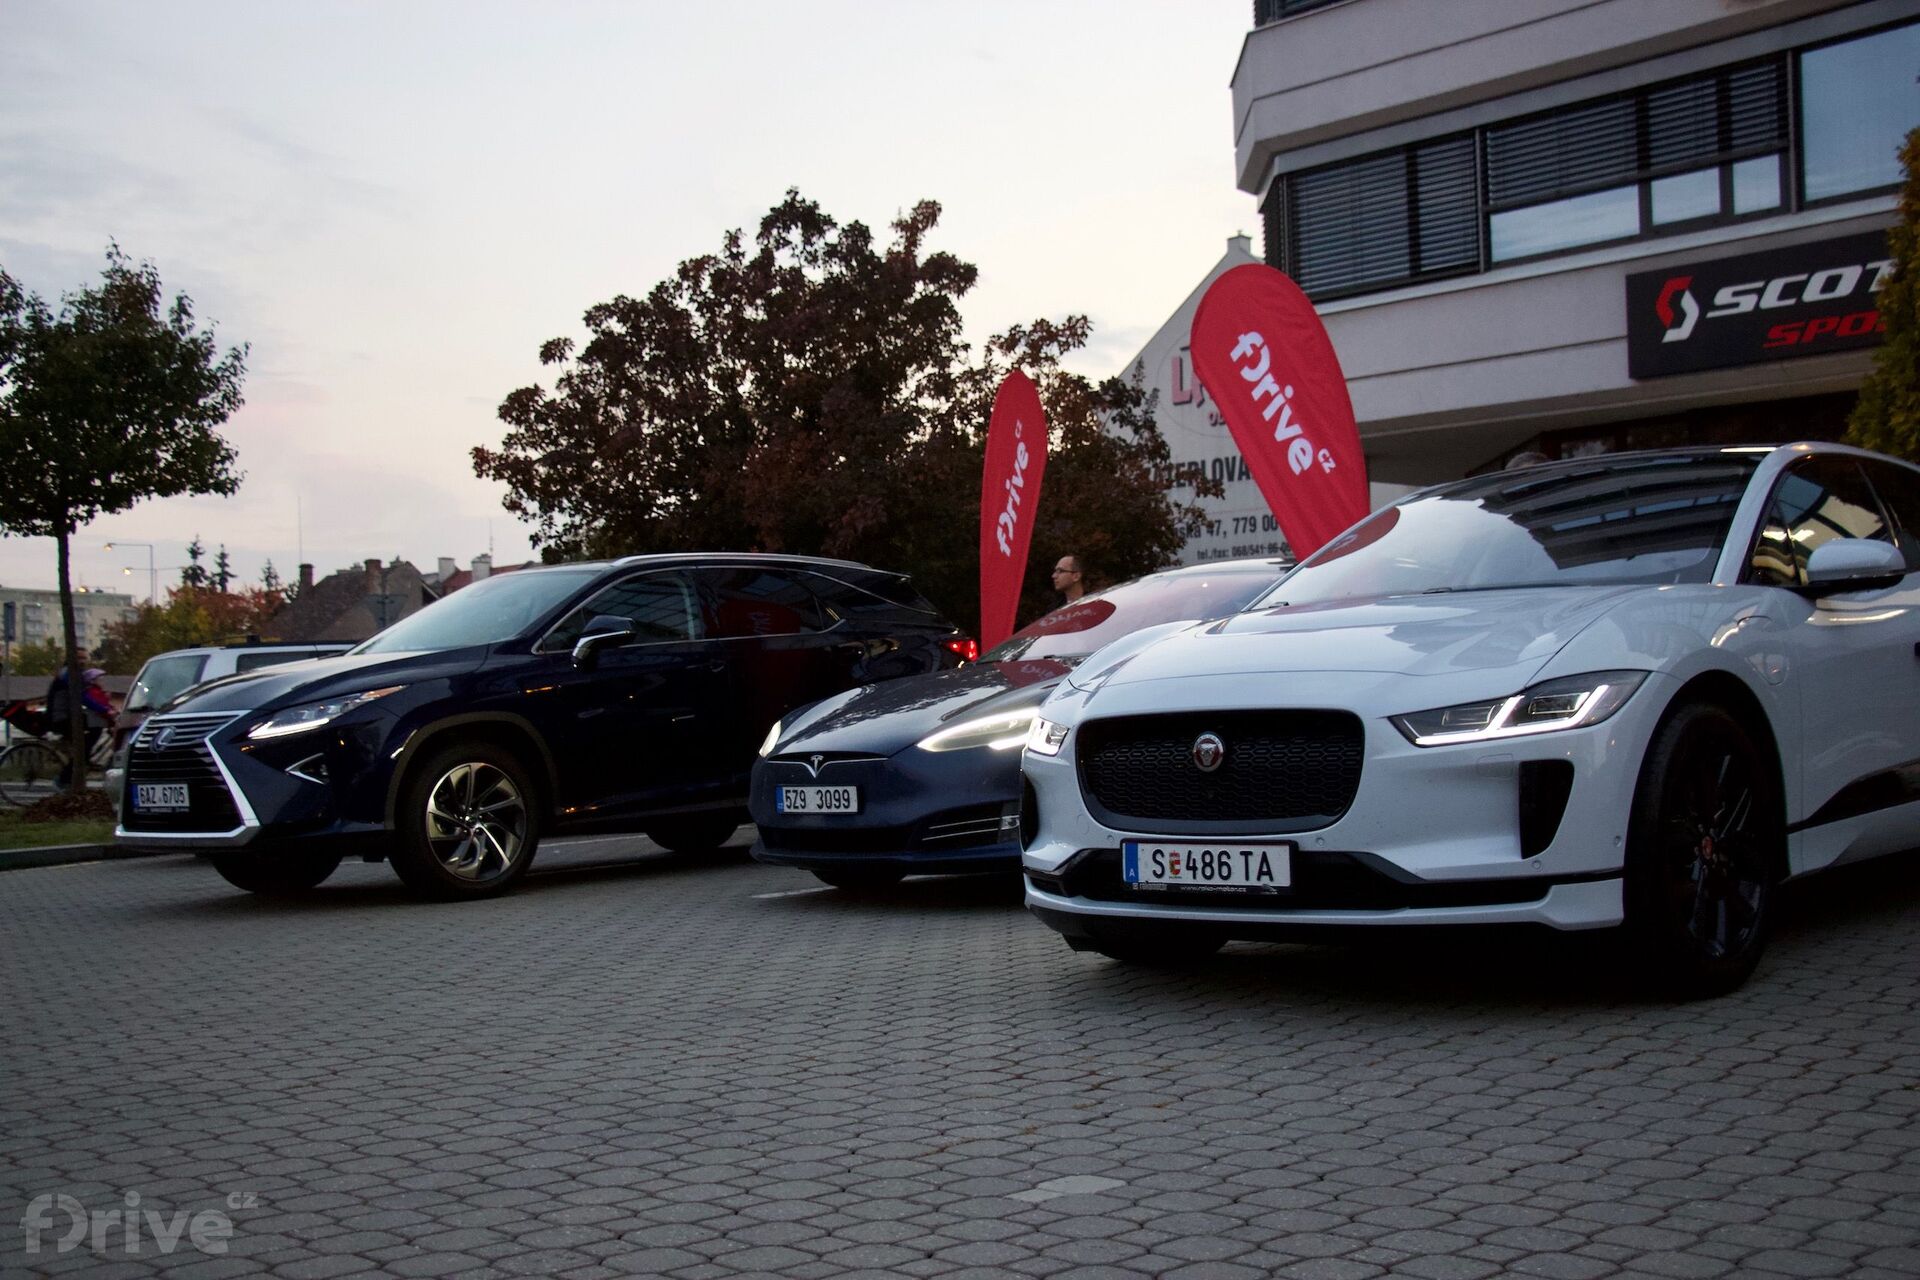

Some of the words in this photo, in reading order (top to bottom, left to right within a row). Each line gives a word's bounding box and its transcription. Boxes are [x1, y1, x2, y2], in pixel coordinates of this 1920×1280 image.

[1762, 311, 1887, 348] SPO
[1233, 516, 1257, 535] 779
[140, 787, 157, 804] 6AZ
[162, 786, 186, 804] 6705
[785, 789, 807, 809] 5Z9
[816, 789, 851, 809] 3099
[1151, 849, 1166, 879] S
[1185, 850, 1232, 881] 486
[1239, 850, 1275, 882] TA
